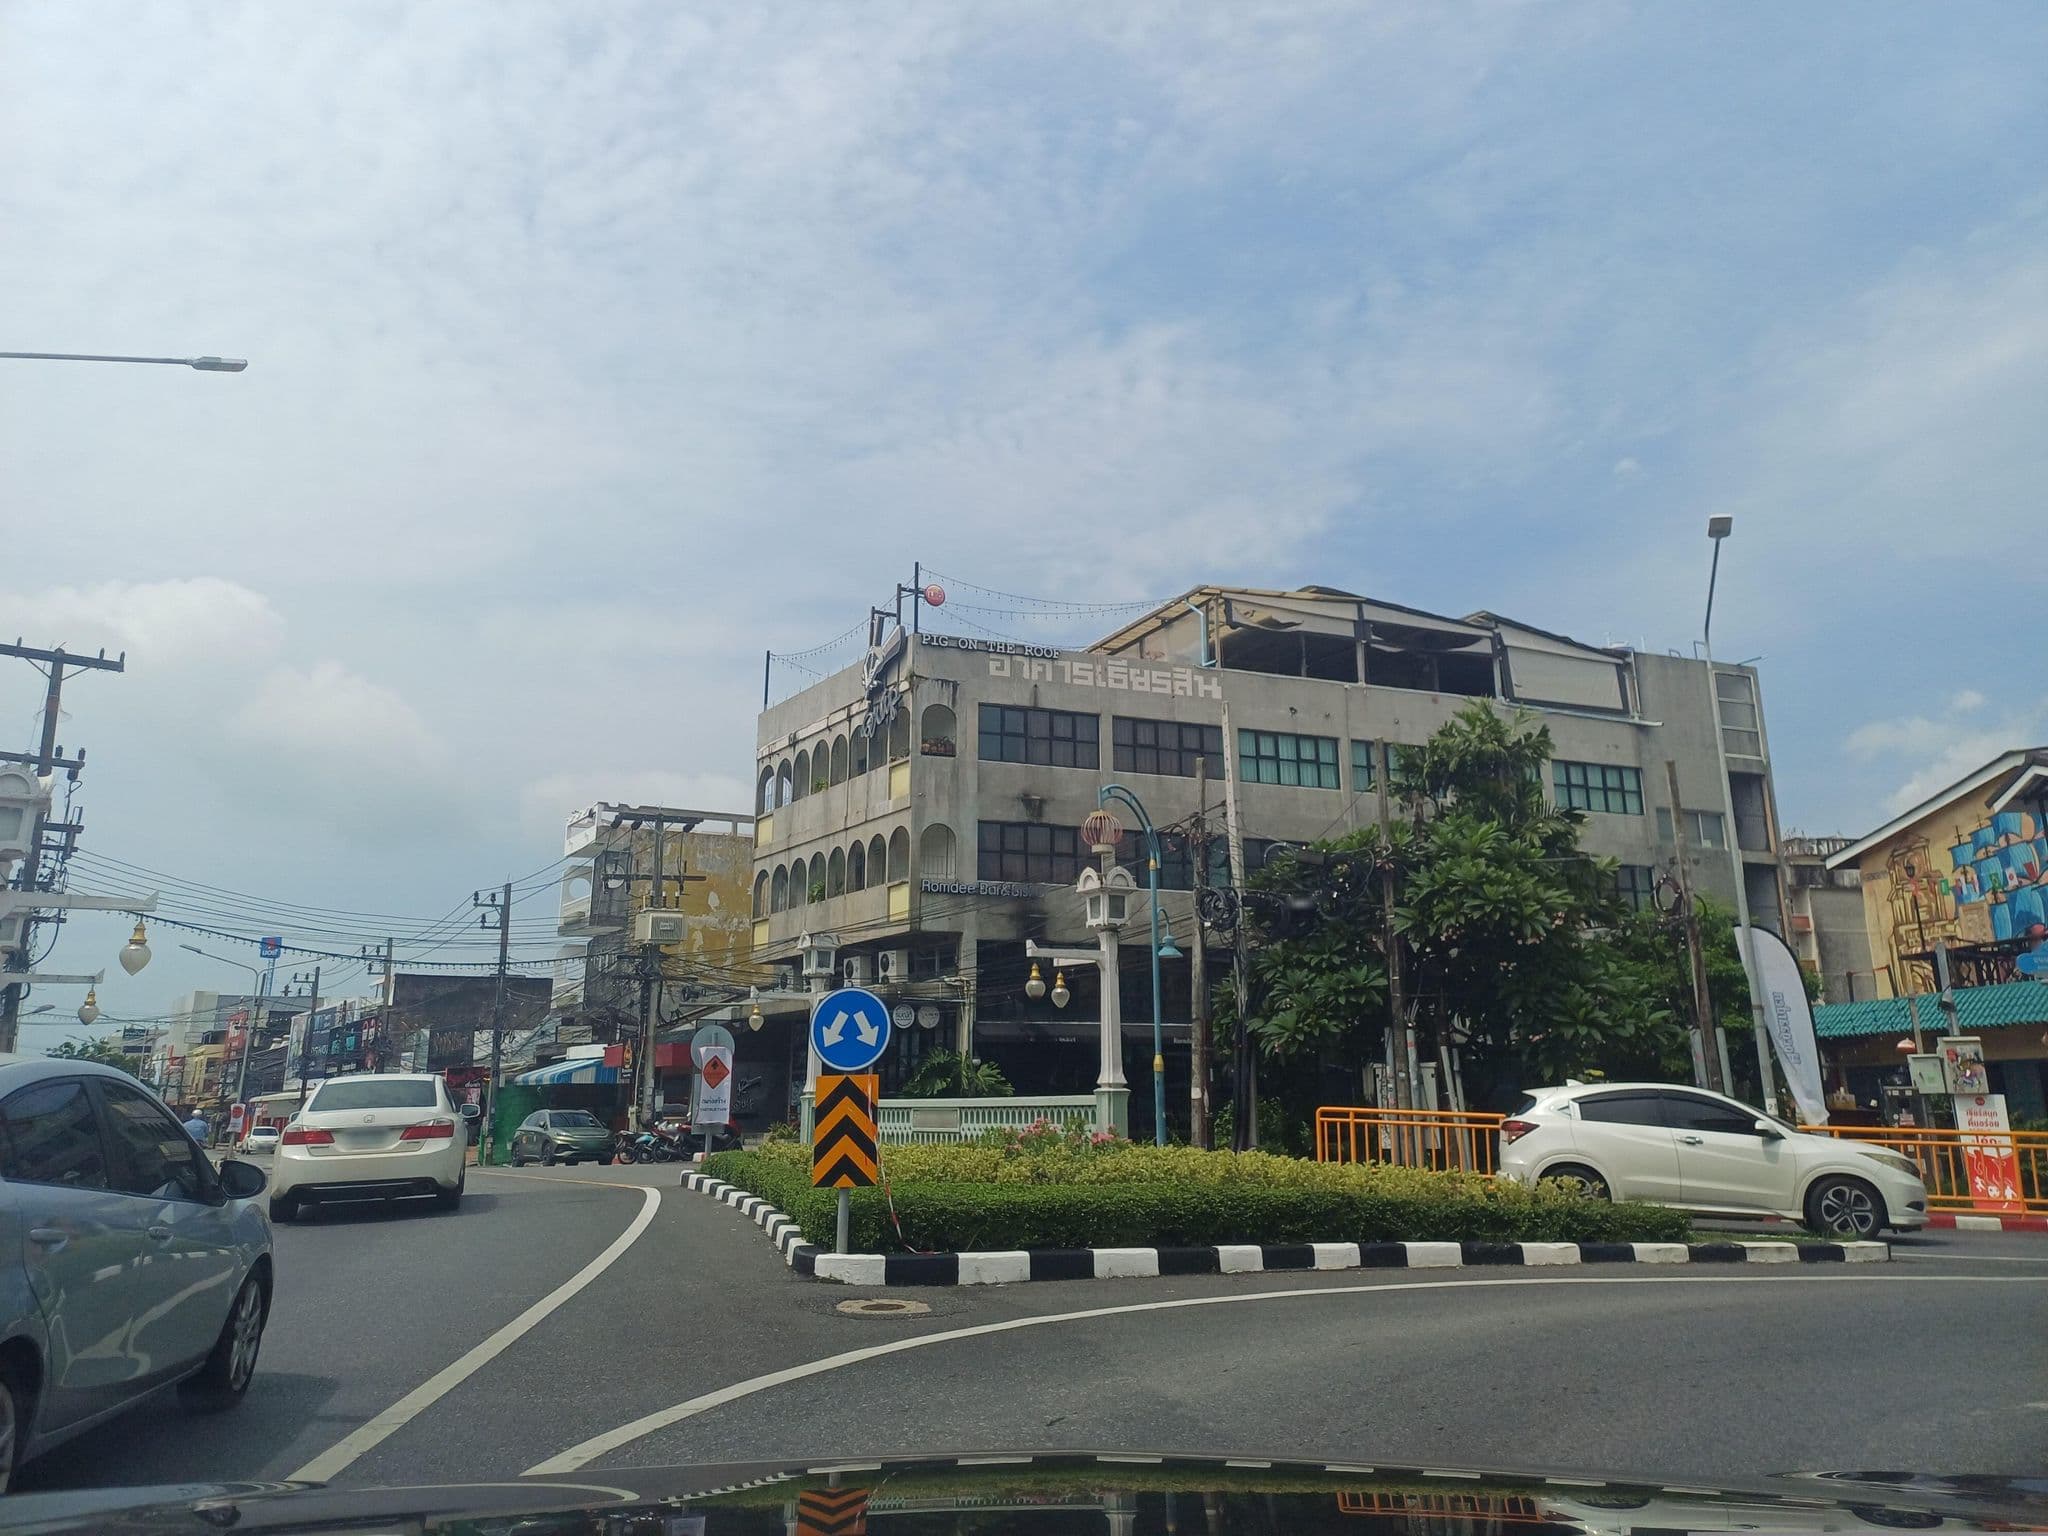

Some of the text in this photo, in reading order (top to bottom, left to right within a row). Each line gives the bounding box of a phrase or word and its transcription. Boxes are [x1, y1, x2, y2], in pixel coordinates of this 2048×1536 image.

[921, 633, 1061, 660] PIG ON THE ROOF
[921, 879, 976, 895] Romdee
